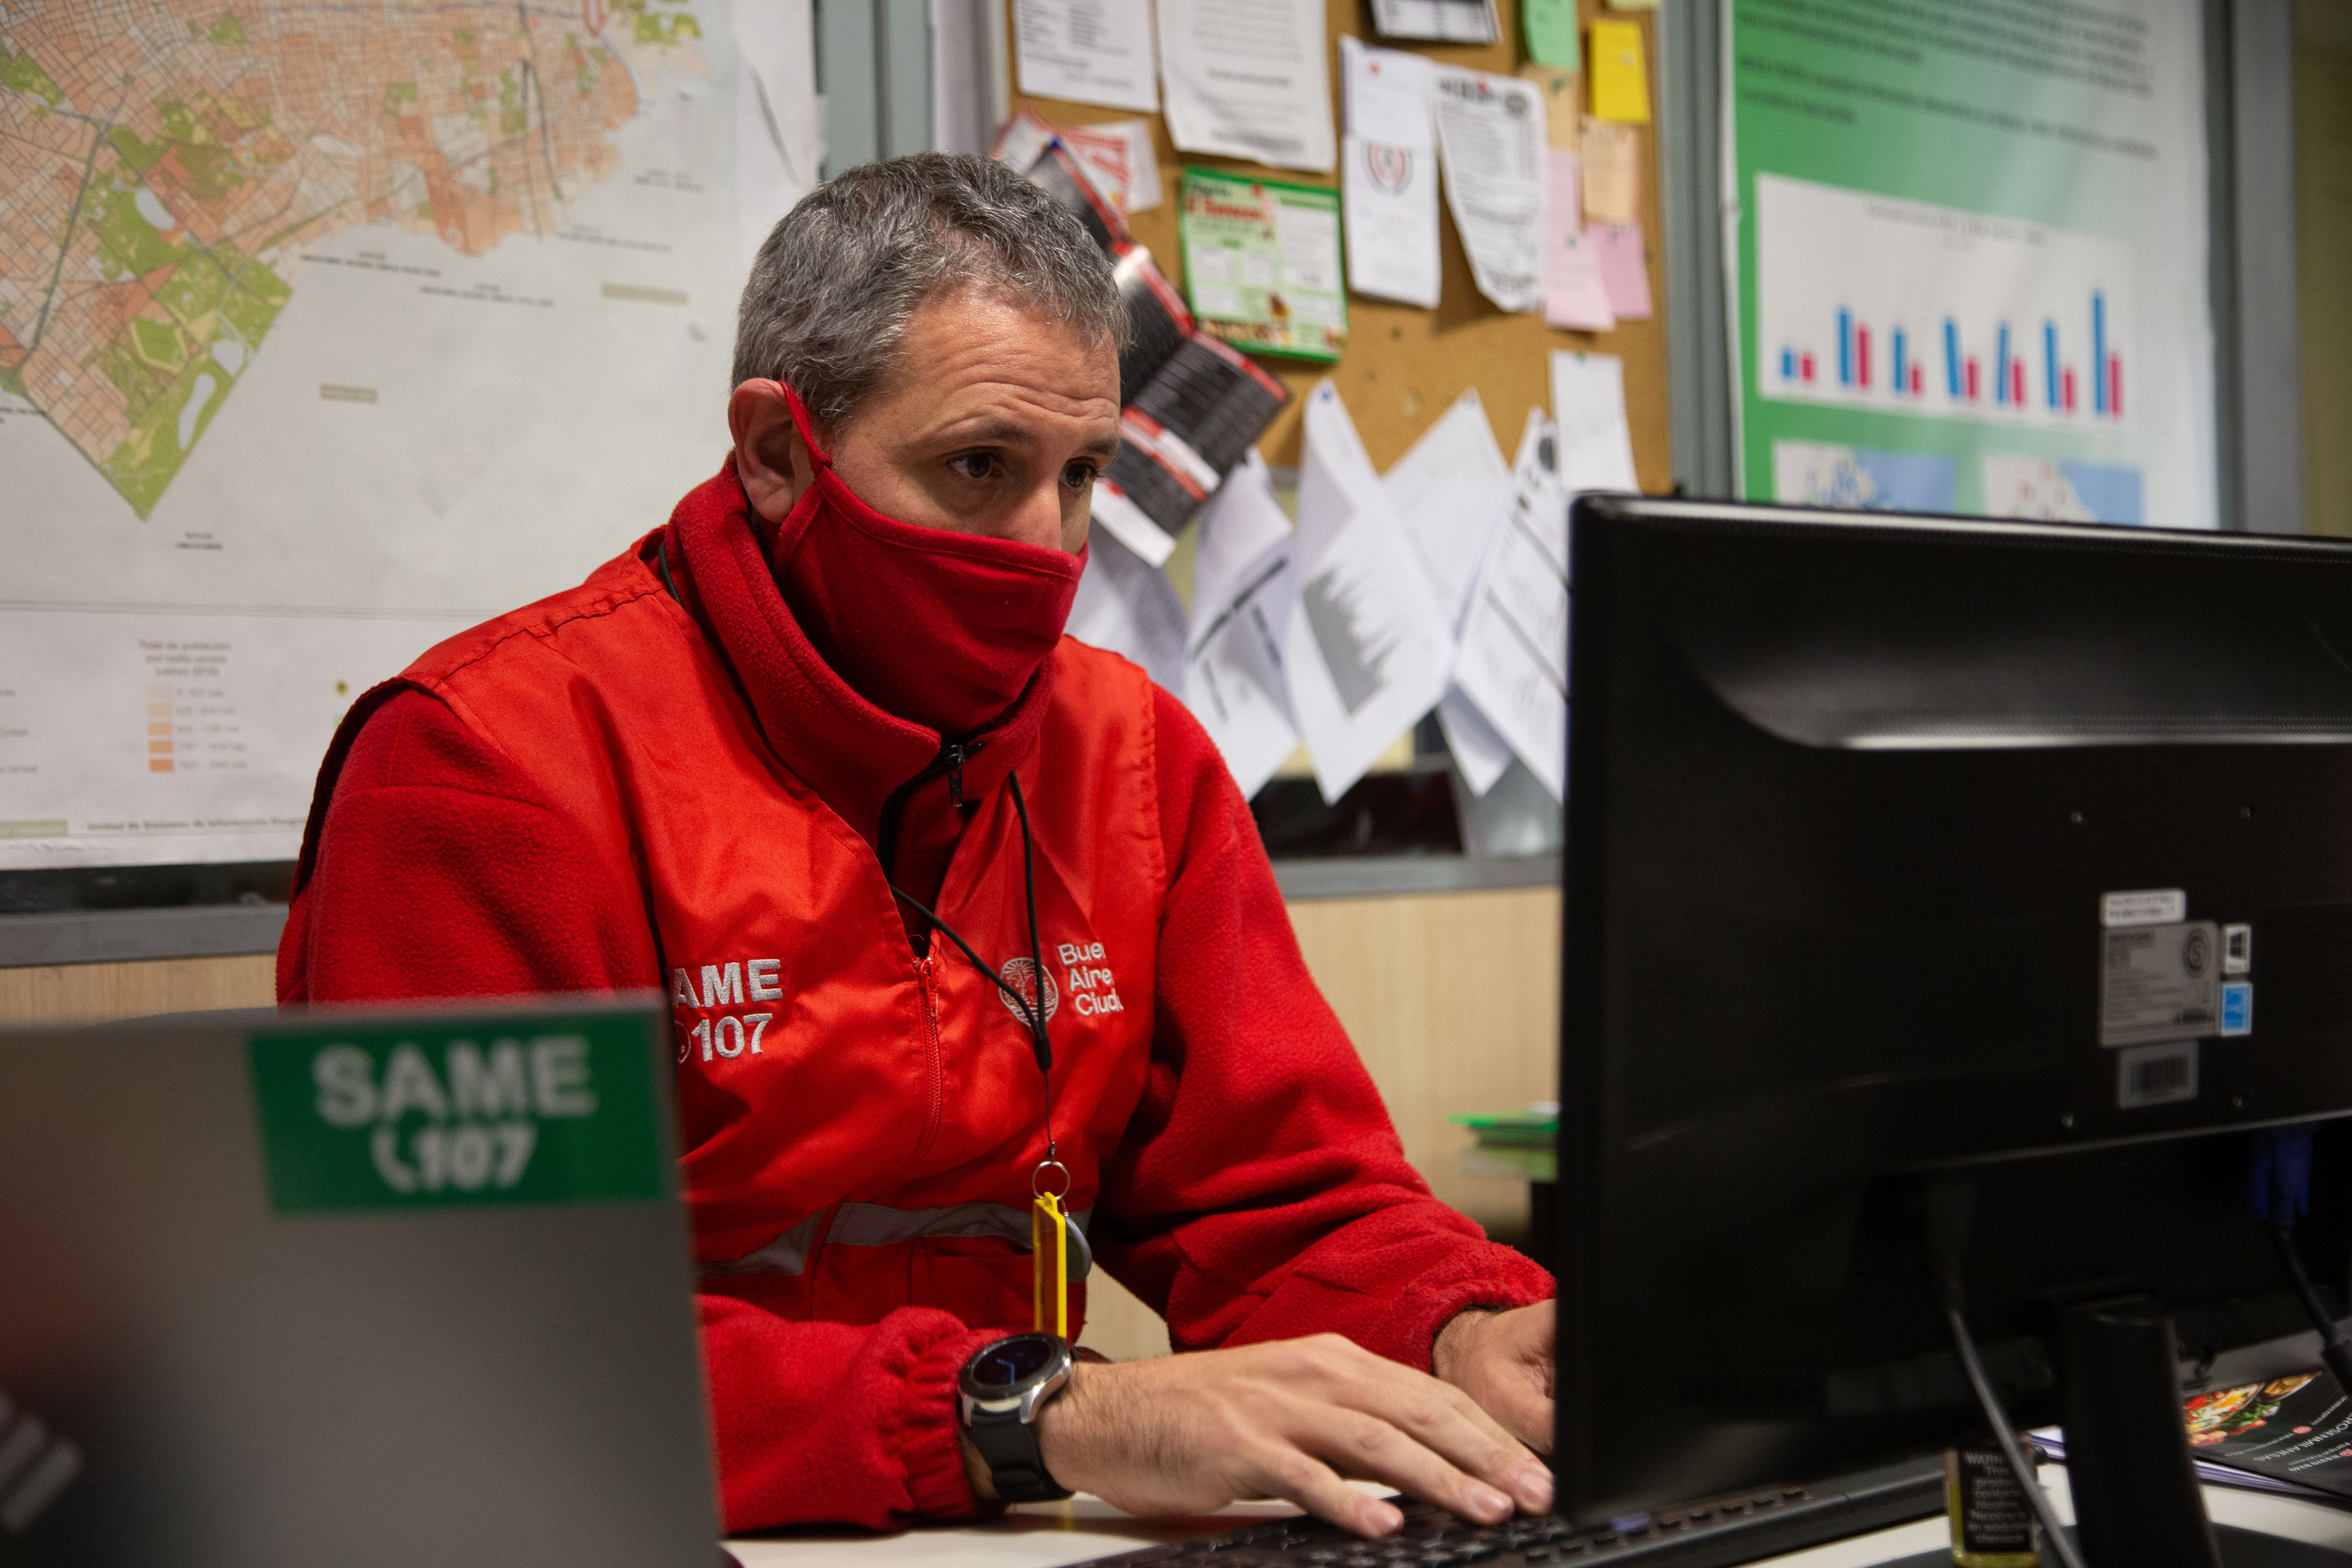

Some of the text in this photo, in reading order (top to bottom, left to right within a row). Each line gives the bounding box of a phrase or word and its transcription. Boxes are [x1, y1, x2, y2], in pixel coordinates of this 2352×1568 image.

[672, 959, 784, 1009] AME
[1069, 966, 1115, 992] Aire
[691, 1013, 773, 1062] 107
[313, 1036, 599, 1127] SAME
[415, 1122, 537, 1191] 107
[1966, 1454, 2003, 1464] WARN
